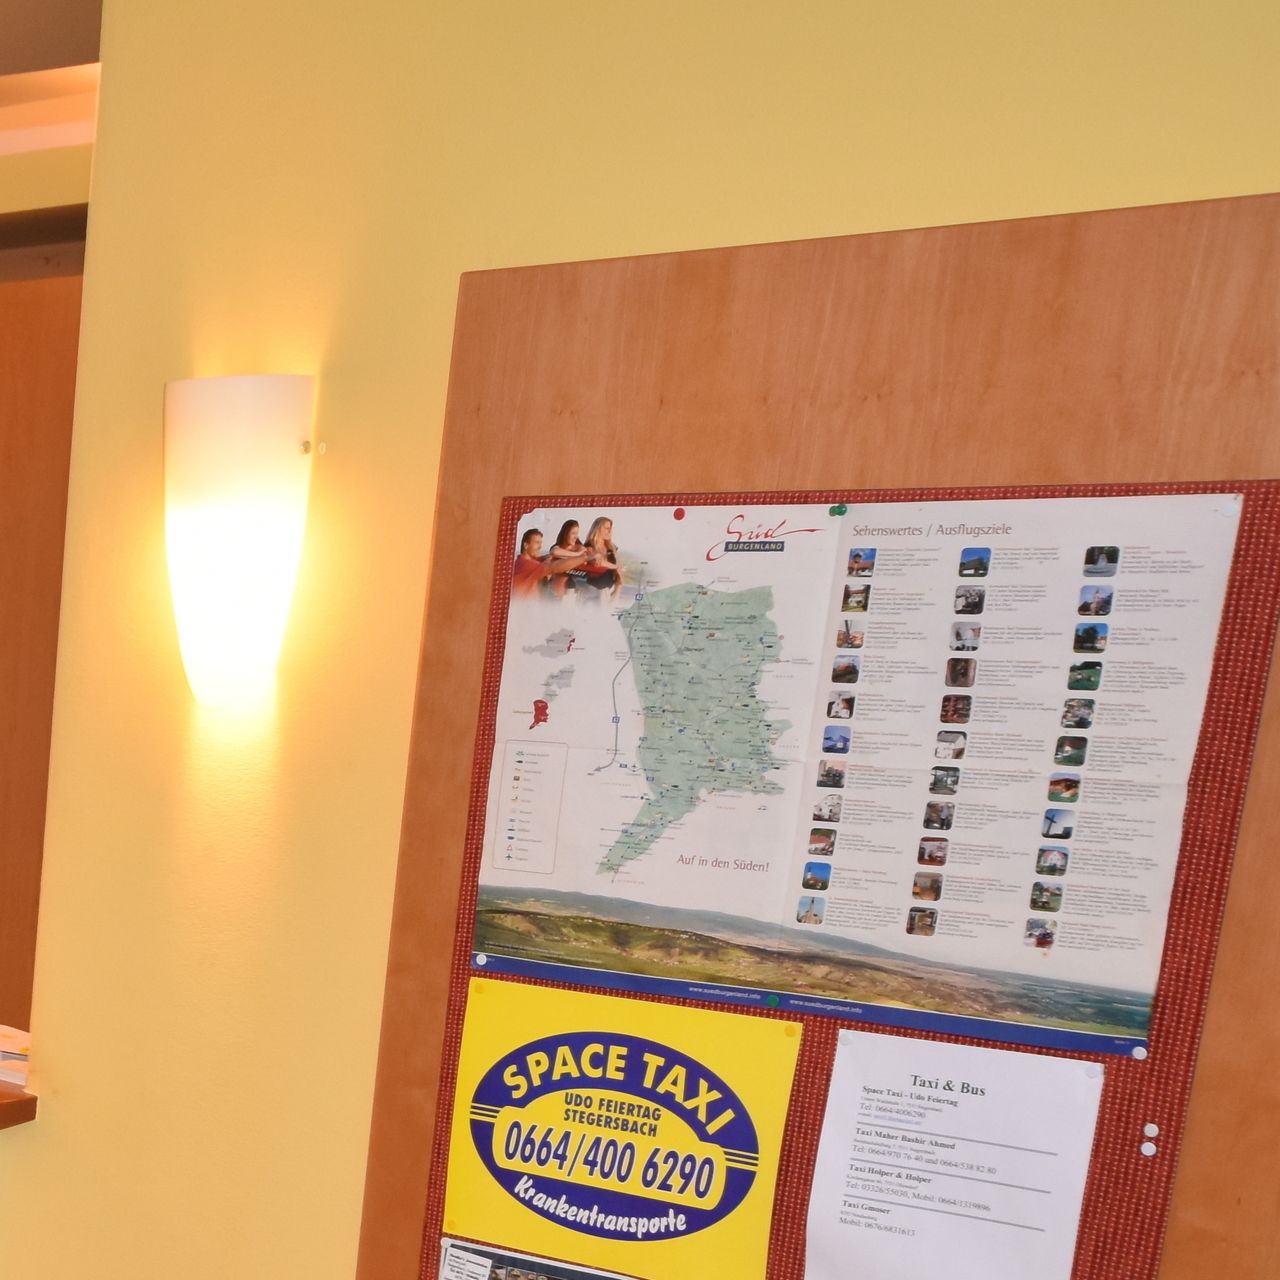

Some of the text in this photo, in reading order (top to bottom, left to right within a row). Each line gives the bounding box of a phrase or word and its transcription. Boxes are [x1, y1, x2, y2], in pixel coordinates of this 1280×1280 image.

[852, 524, 923, 538] Sehenswertes
[936, 522, 1013, 537] Ausflugsziele
[727, 541, 784, 552] BURGENLAND
[676, 853, 770, 873] Auf in den Süden!
[502, 1043, 736, 1136] SPACE TAXI
[862, 1085, 884, 1096] Space
[886, 1088, 903, 1098] Taxi
[910, 1092, 926, 1101] Udo
[927, 1095, 959, 1108] Feiertag
[910, 1074, 986, 1097] Taxi & Bus
[564, 1091, 662, 1122] UDO FEIERTAG
[563, 1108, 658, 1138] STEGERSBACH
[855, 1127, 873, 1137] Taxi
[874, 1130, 900, 1141] Maher
[901, 1134, 926, 1145] Bashir
[929, 1139, 956, 1150] Ahmed
[505, 1120, 715, 1200] 0664/400 6290
[924, 1156, 939, 1165] und
[848, 1163, 866, 1173] Taxi
[867, 1166, 894, 1179] Holper
[895, 1171, 904, 1179] &
[905, 1173, 933, 1185] Holper
[514, 1174, 687, 1238] Krankentransporte
[841, 1200, 892, 1215] Taxi Gmoser
[912, 1192, 936, 1202] Mobil:
[838, 1217, 863, 1228] Mobil:
